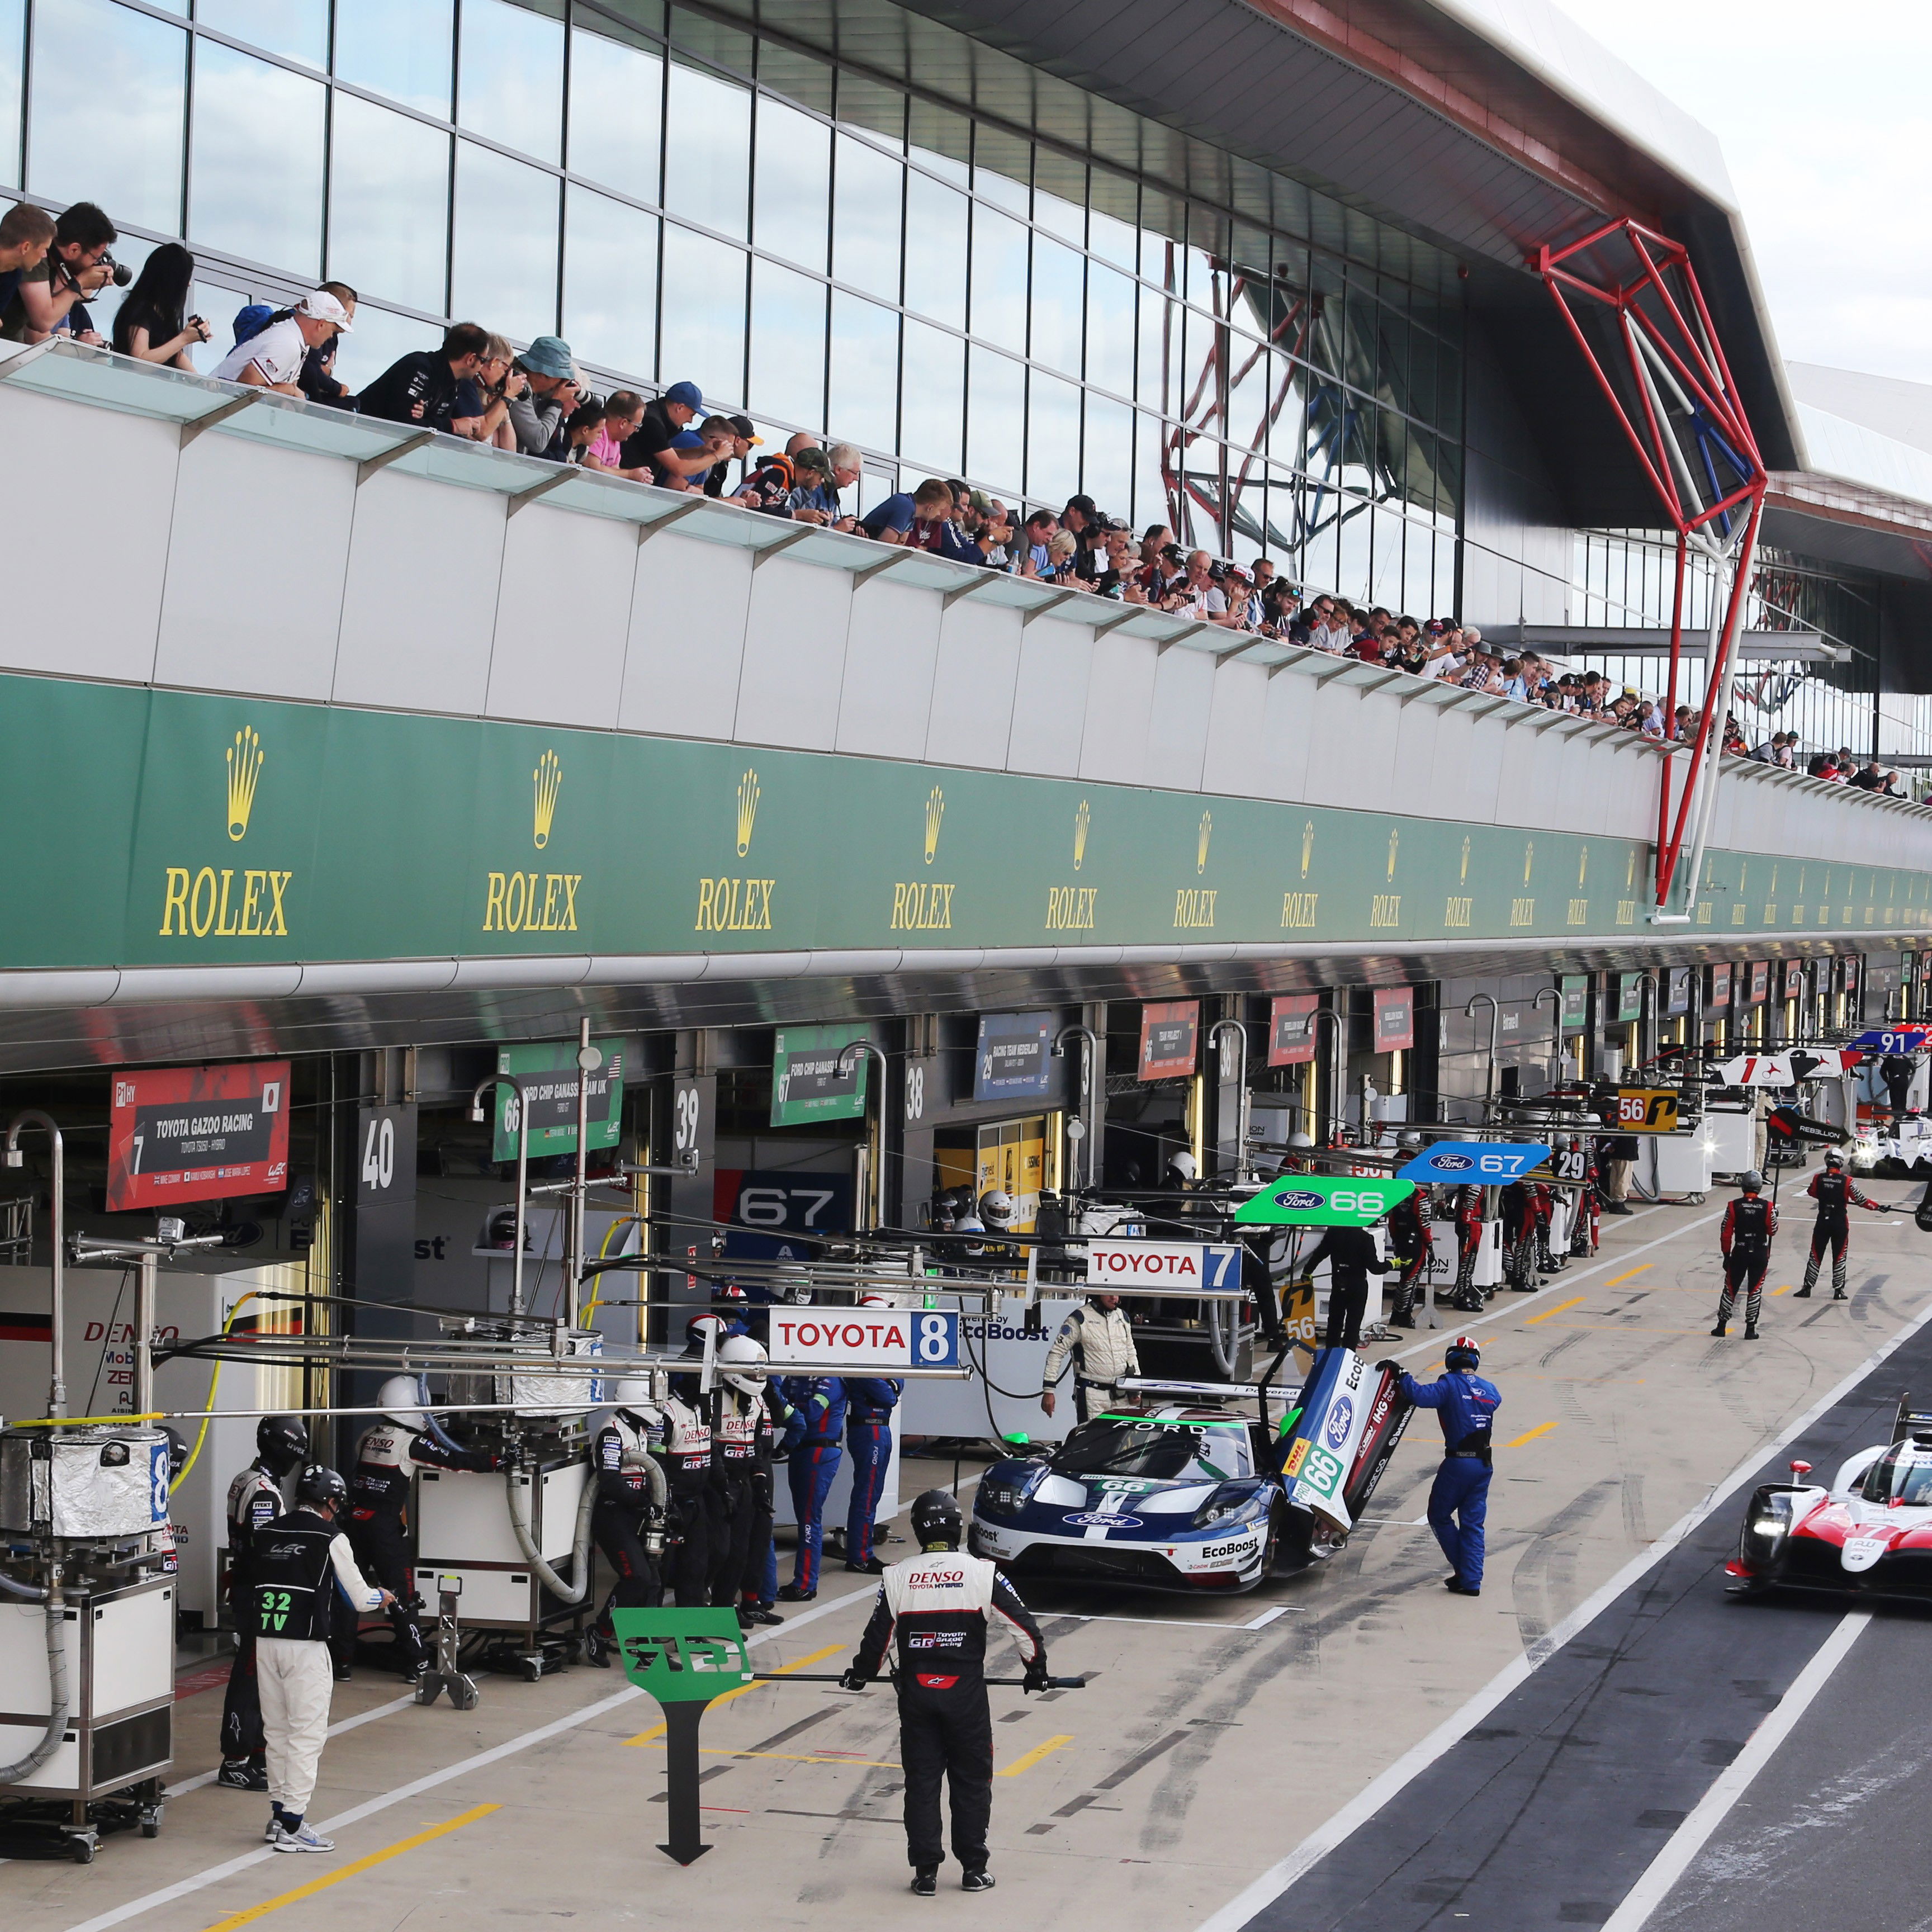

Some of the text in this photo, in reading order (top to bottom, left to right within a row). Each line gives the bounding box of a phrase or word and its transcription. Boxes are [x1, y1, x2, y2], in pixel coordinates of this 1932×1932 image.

[159, 866, 292, 937] ROLEX
[482, 871, 582, 933] ROLEX
[694, 877, 776, 932] ROLEX
[889, 882, 955, 931] ROLEX
[1045, 886, 1097, 930] ROLEX
[1173, 888, 1217, 928] ROLEX
[1281, 892, 1318, 928] ROLEX
[1370, 894, 1401, 927] ROLEX
[1445, 897, 1472, 927] ROLEX
[1510, 898, 1535, 926] ROLEX
[1567, 899, 1588, 925] ROLEX
[1145, 1039, 1153, 1062] 56
[1881, 1033, 1905, 1052] 91
[983, 1054, 992, 1079] 29
[1220, 1035, 1232, 1077] 36
[791, 1063, 803, 1077] FORD
[804, 1062, 815, 1076] CHIP
[1740, 1058, 1757, 1083] 1
[126, 1085, 136, 1102] HY
[524, 1086, 538, 1102] ORD
[538, 1084, 553, 1101] CHIP
[598, 1079, 607, 1094] UK
[778, 1074, 790, 1103] 67
[907, 1067, 923, 1120] 38
[504, 1098, 520, 1133] 66
[676, 1088, 699, 1150] 39
[1620, 1098, 1644, 1120] 56
[157, 1113, 253, 1139] TOYOTA GAZOO RACING
[134, 1136, 144, 1175] 7
[362, 1118, 394, 1190] 40
[1437, 1154, 1524, 1173] Ford 67
[1558, 1151, 1585, 1180] 29
[740, 1188, 834, 1226] 67
[1283, 1191, 1384, 1212] Ford 66
[1092, 1247, 1235, 1287] TOYOTA 7
[84, 1322, 179, 1343] DENO
[778, 1314, 949, 1362] TOYOTA 8
[1287, 1317, 1316, 1341] 56
[1327, 1403, 1352, 1443] Ford
[1372, 1400, 1388, 1424] IHG
[684, 1427, 711, 1440] DENSO
[1112, 1420, 1207, 1435] FORD
[287, 1442, 305, 1455] uvex
[365, 1436, 395, 1448] ENSO
[724, 1450, 745, 1458] GR
[683, 1461, 702, 1469] GR
[1287, 1442, 1306, 1471] DHL
[154, 1451, 168, 1513] 8
[1304, 1450, 1338, 1491] 66
[1101, 1481, 1147, 1492] 66
[1295, 1481, 1310, 1499] PRO
[923, 1517, 946, 1528] ux
[1077, 1513, 1129, 1526] Ford
[1863, 1524, 1888, 1537] 7
[269, 1543, 306, 1555] WEC
[1202, 1536, 1258, 1559] EcoBoost
[908, 1571, 964, 1584] DENSO
[261, 1592, 290, 1611] 32
[261, 1612, 287, 1631] TV
[910, 1638, 935, 1647] GR
